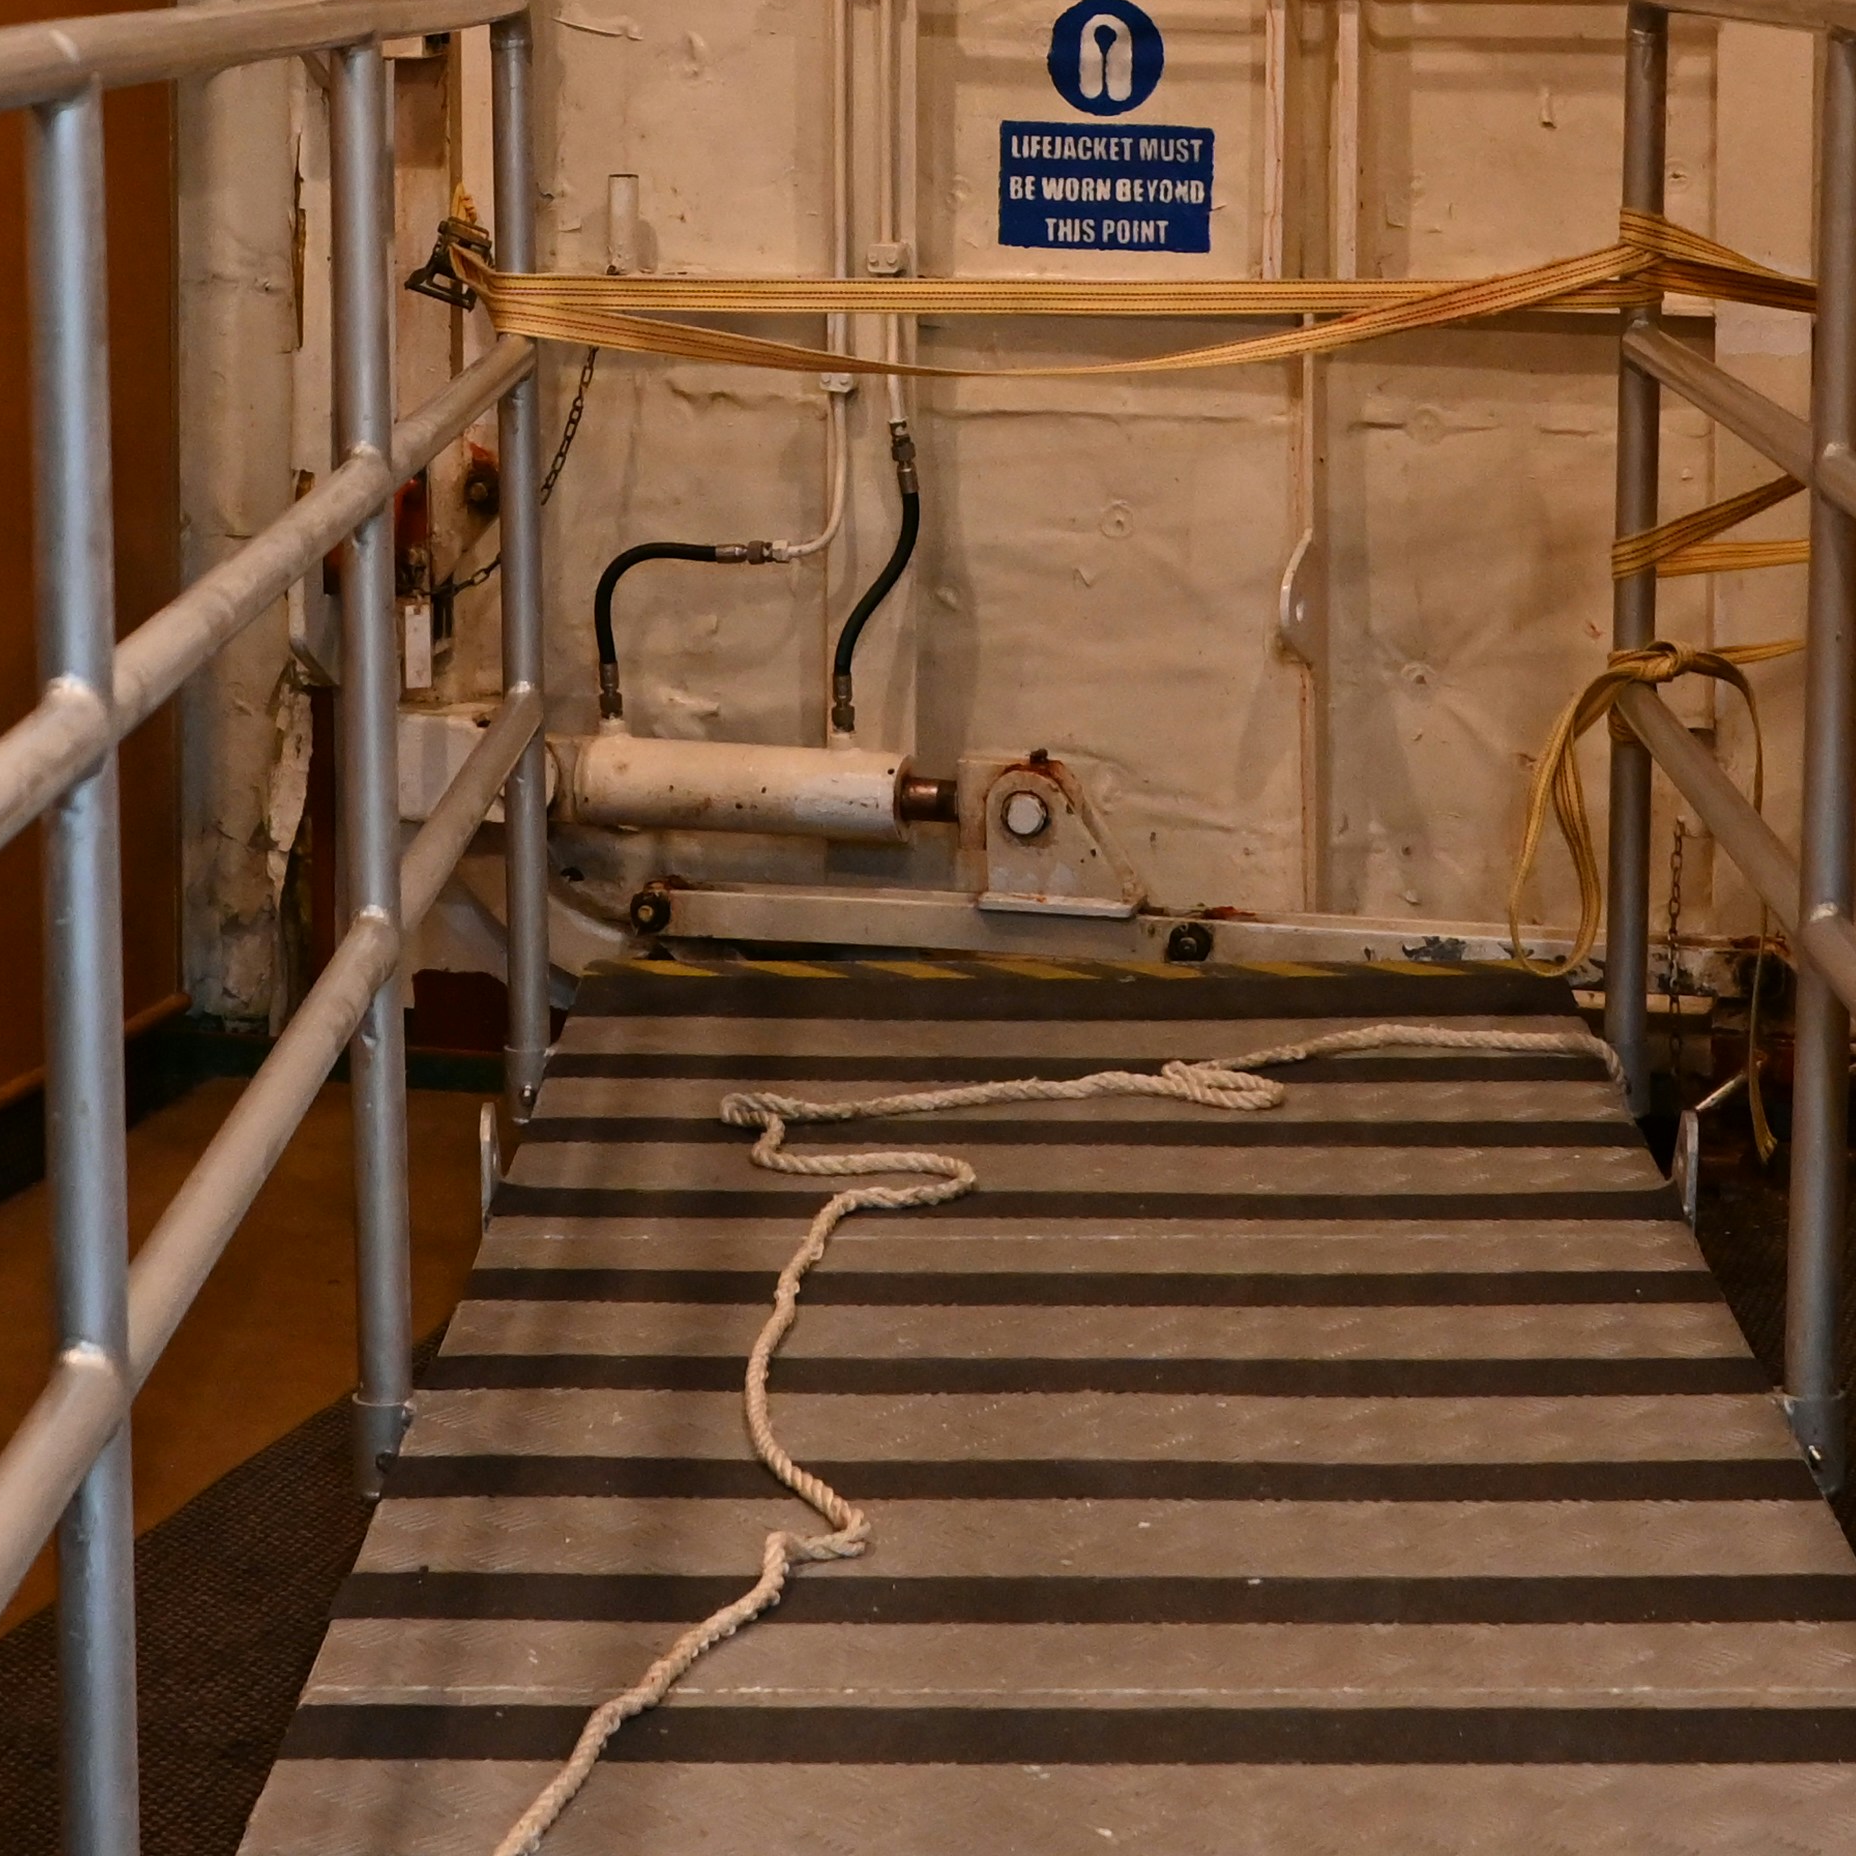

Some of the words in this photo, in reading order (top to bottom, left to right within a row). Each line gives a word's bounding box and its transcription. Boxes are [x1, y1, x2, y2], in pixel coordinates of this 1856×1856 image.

[1011, 134, 1134, 161] LIFEJACKET
[1139, 138, 1204, 163] MUST
[1009, 175, 1035, 200] BE
[1042, 176, 1111, 202] WORN
[1115, 178, 1205, 204] BEYOND
[1045, 217, 1095, 243] THIS
[1102, 219, 1169, 244] POINT
